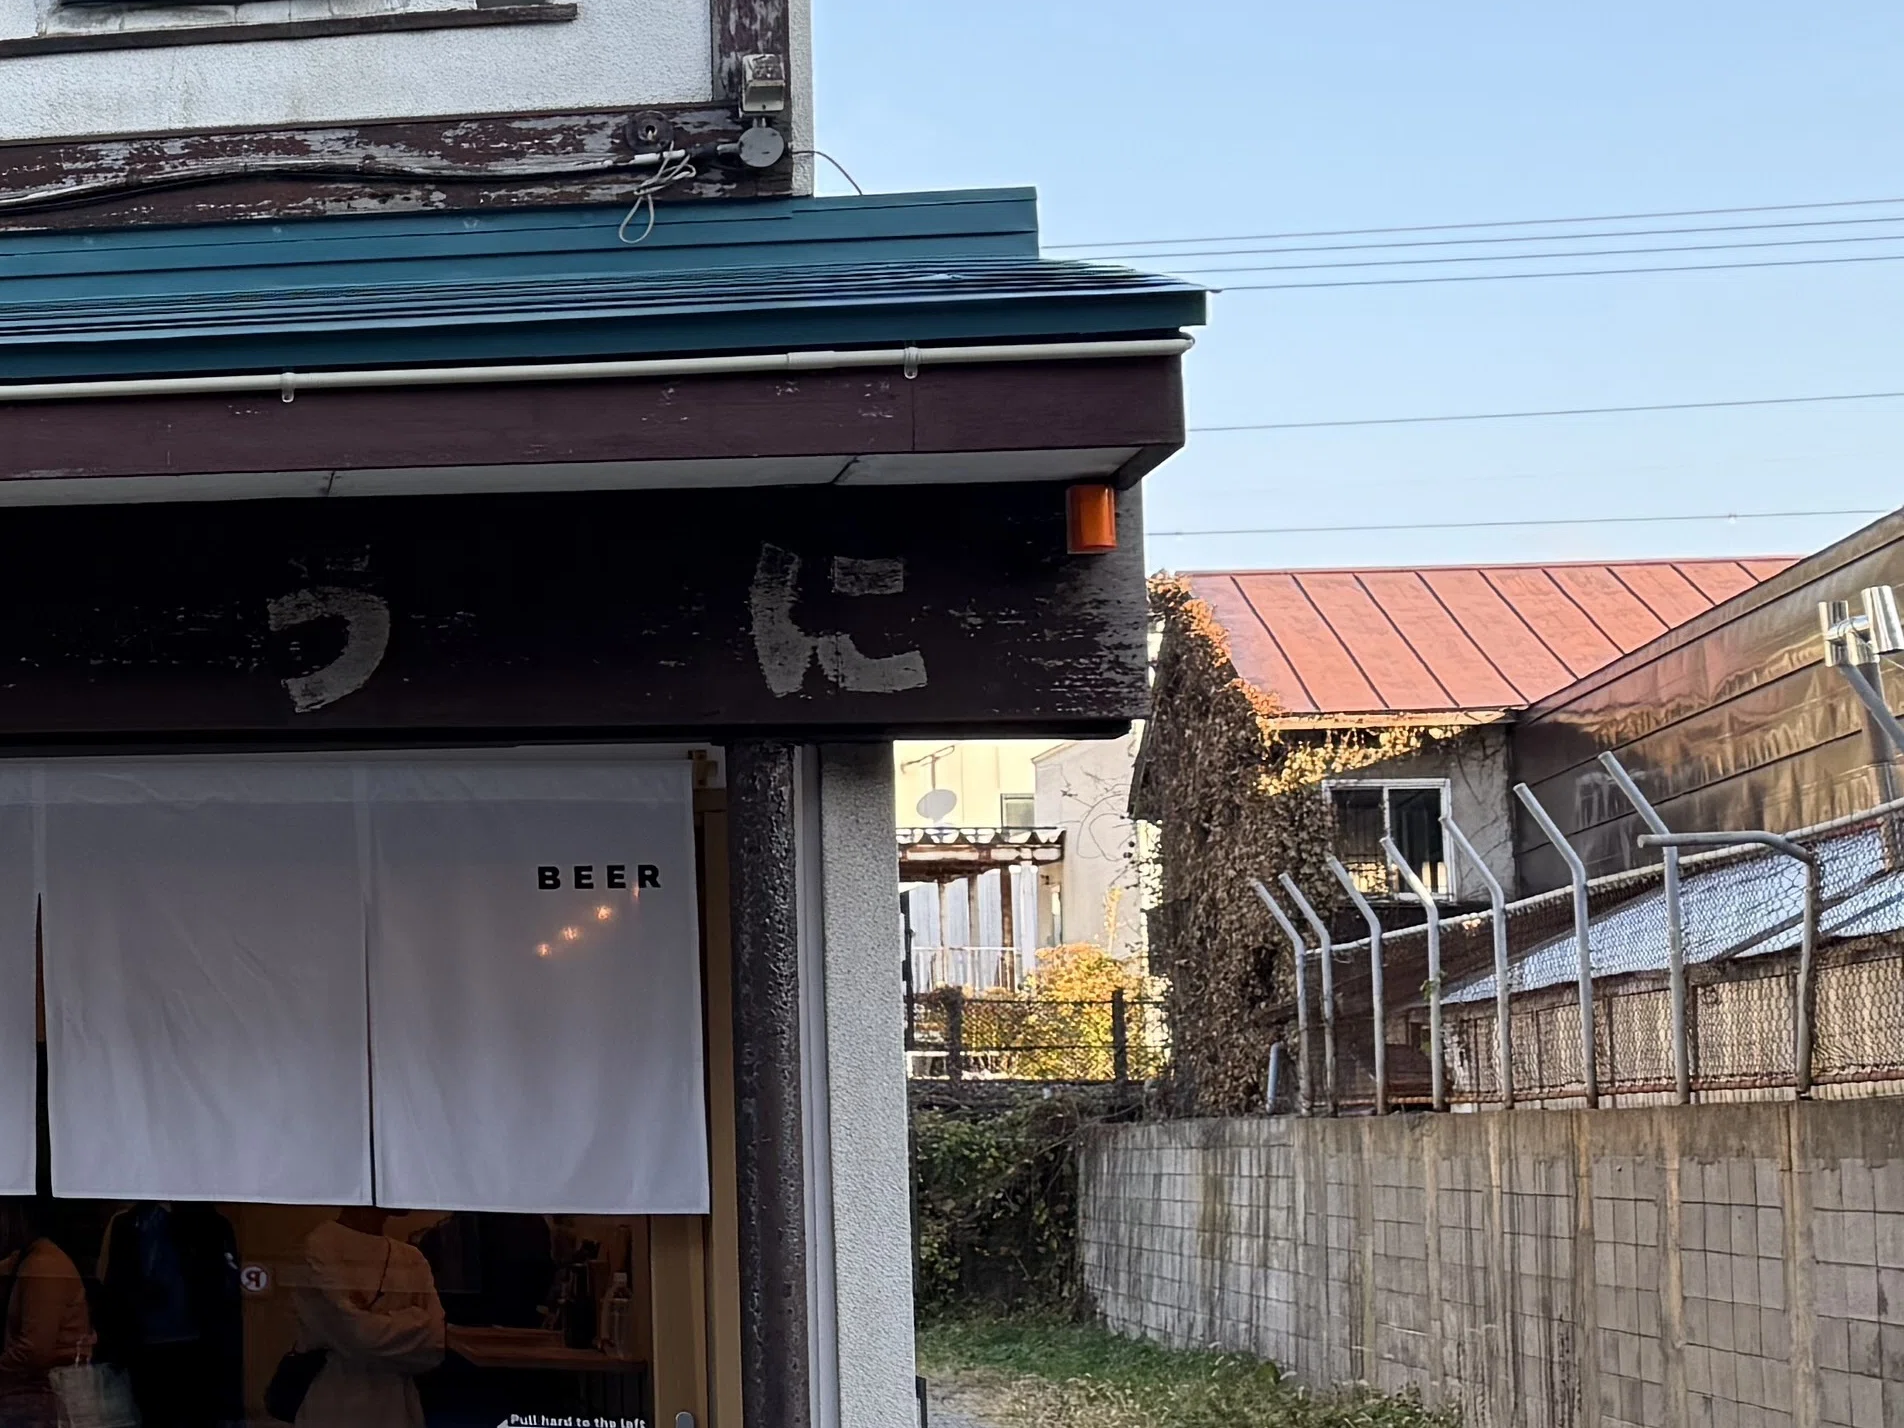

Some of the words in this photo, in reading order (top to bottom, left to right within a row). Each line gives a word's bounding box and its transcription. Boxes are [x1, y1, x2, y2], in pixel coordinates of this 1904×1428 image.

[537, 864, 661, 890] BEER
[510, 1413, 537, 1426] Pull
[540, 1415, 573, 1427] hard
[576, 1417, 590, 1428] to
